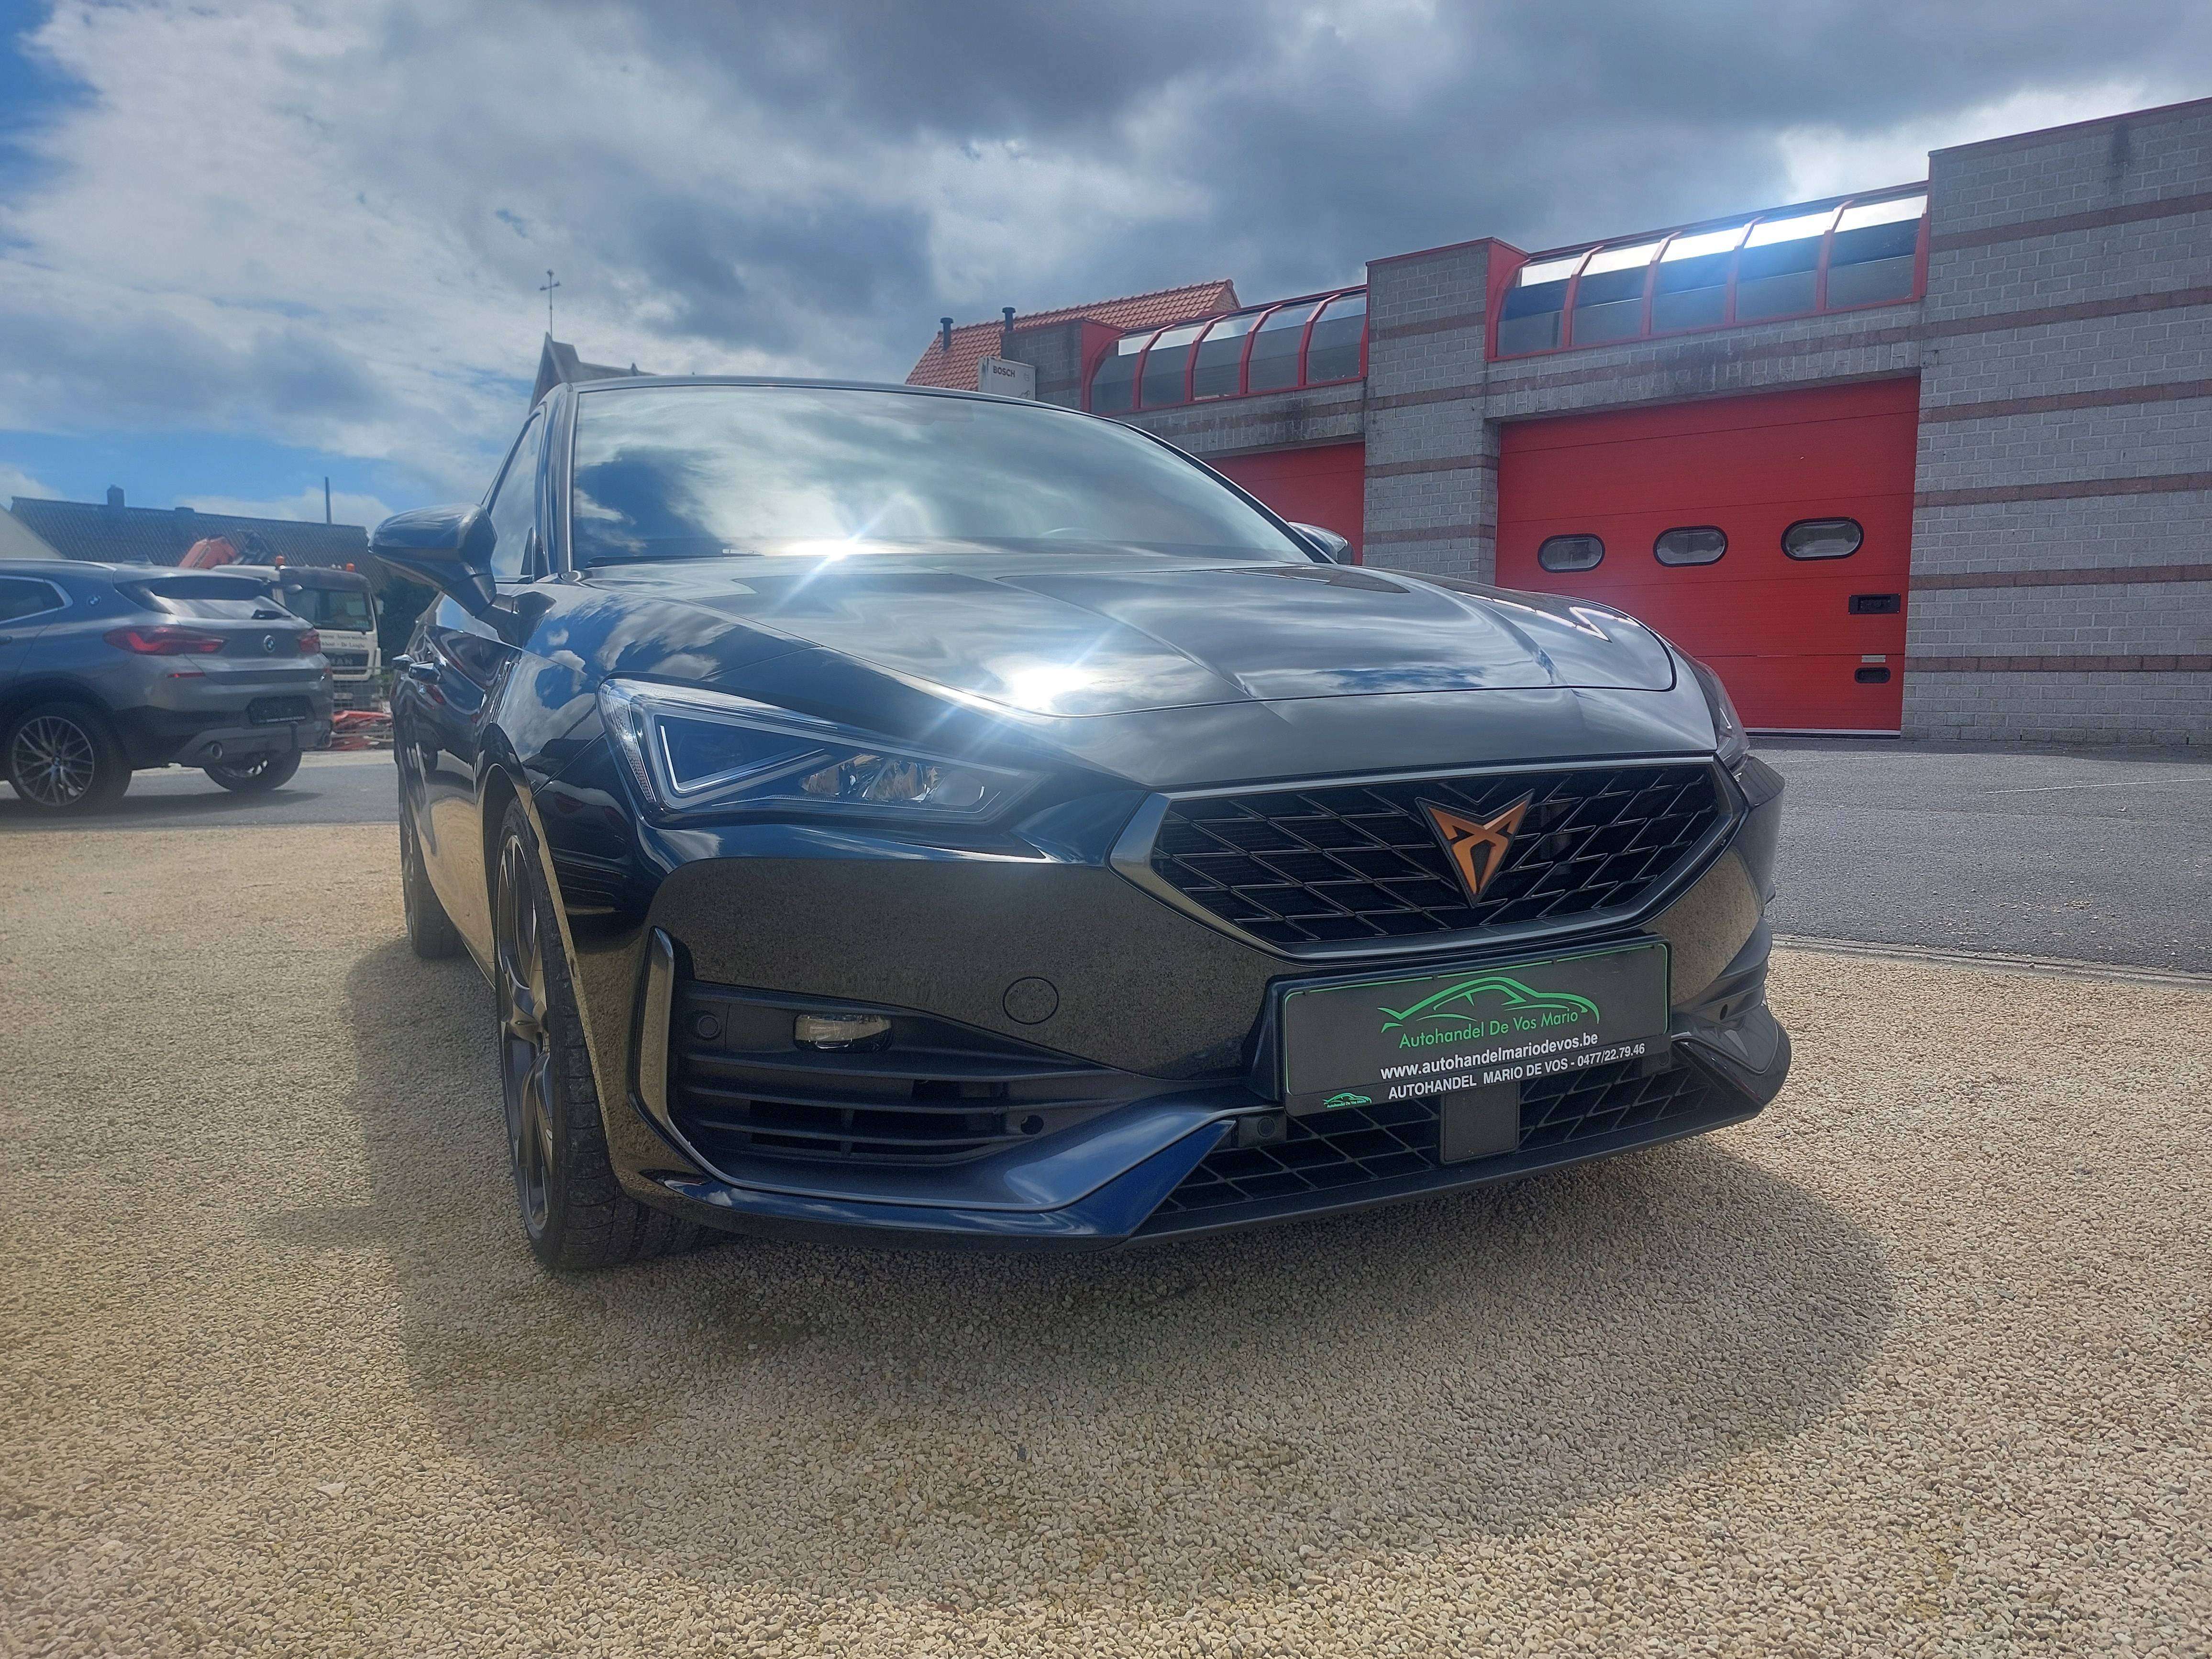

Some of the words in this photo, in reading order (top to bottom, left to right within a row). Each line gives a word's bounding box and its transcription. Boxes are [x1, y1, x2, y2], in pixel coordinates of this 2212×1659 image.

[993, 365, 1015, 377] BOSCH
[1399, 1021, 1484, 1049] Autohandel
[1490, 1020, 1509, 1036] De
[1513, 1016, 1537, 1031] Vos
[1540, 1009, 1578, 1028] Mario
[1380, 1032, 1598, 1080] www.autohandelmariodevos.be
[1388, 1074, 1477, 1100] AUTOHANDEL
[1483, 1066, 1523, 1084] MARIO
[1526, 1062, 1542, 1076] DE
[1544, 1058, 1568, 1073] VOS
[1577, 1043, 1645, 1067] 0477/22.79.46
